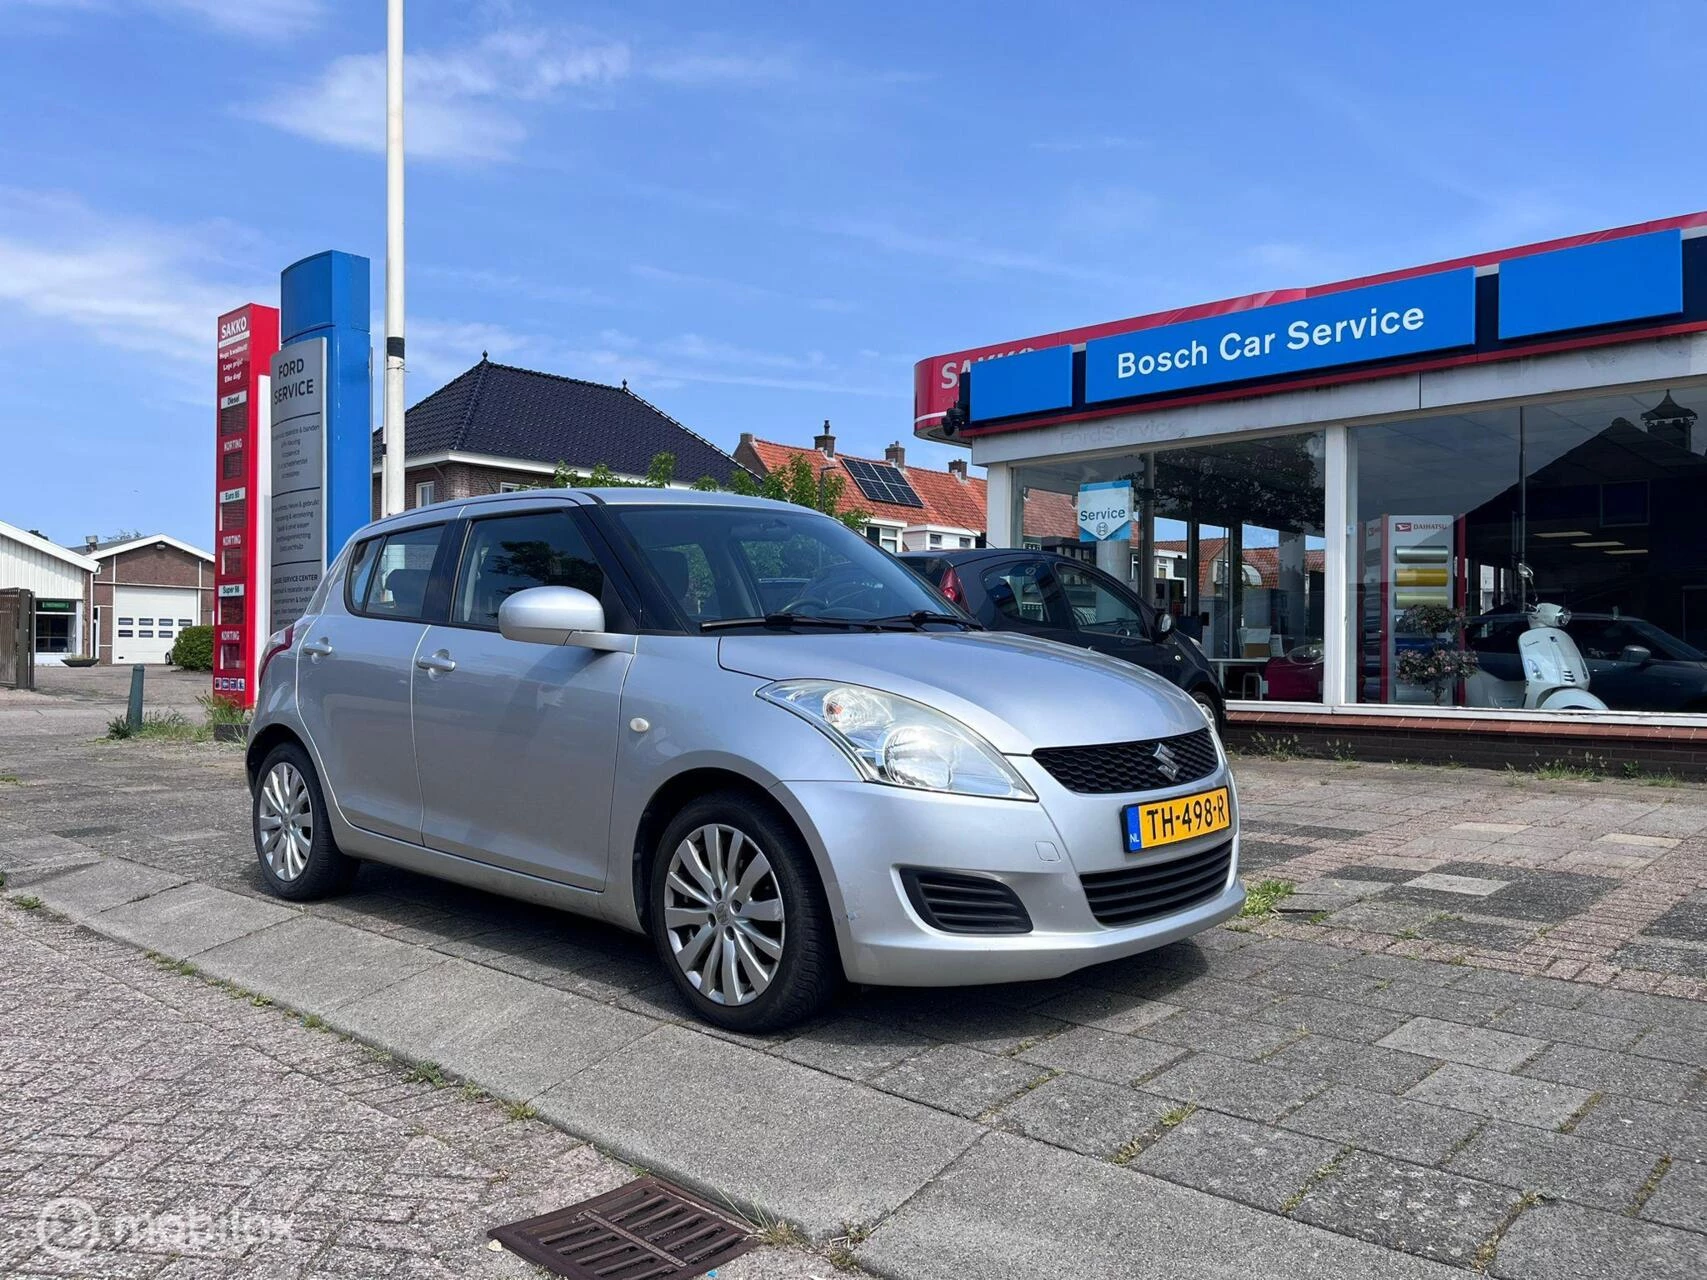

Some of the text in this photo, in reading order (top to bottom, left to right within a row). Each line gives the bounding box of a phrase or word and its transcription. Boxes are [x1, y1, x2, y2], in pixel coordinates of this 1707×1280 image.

[221, 316, 247, 339] SAKKO
[1117, 307, 1425, 379] Bosch Car Service
[278, 358, 305, 380] FORD
[274, 378, 314, 405] SERVICE
[227, 395, 240, 405] Diesel
[224, 438, 242, 451] KORTING
[225, 491, 235, 501] Euro
[1080, 507, 1126, 522] Service
[299, 574, 318, 582] CENTER
[222, 586, 234, 594] Super
[1146, 794, 1226, 840] TH-498-R
[1129, 832, 1140, 843] NL
